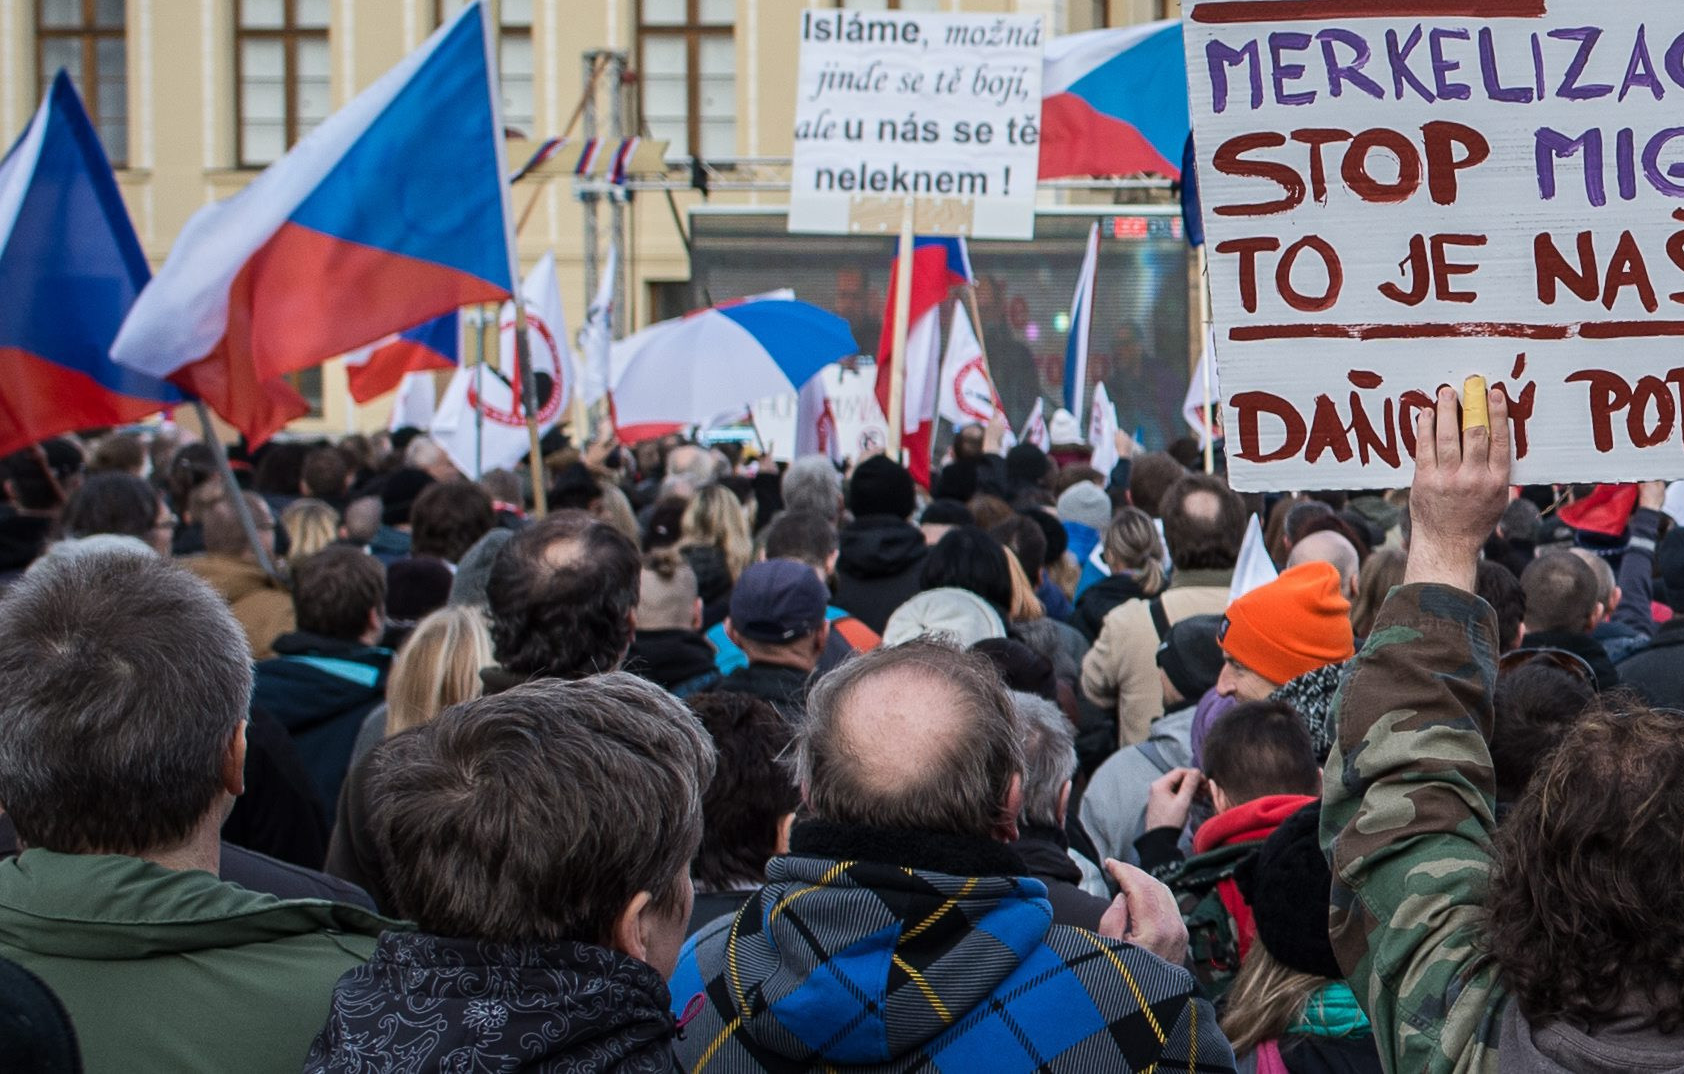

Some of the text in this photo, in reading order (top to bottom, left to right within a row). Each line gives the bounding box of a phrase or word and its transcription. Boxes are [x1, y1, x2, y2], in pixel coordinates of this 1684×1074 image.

[803, 11, 1042, 49] Isláme, možná
[808, 60, 1030, 107] jinde se tě bojí,
[794, 109, 1040, 145] ale u nás se tě
[814, 161, 988, 195] neleknem
[1213, 120, 1489, 216] STOP
[1218, 236, 1342, 312] TO
[1381, 235, 1486, 305] JE
